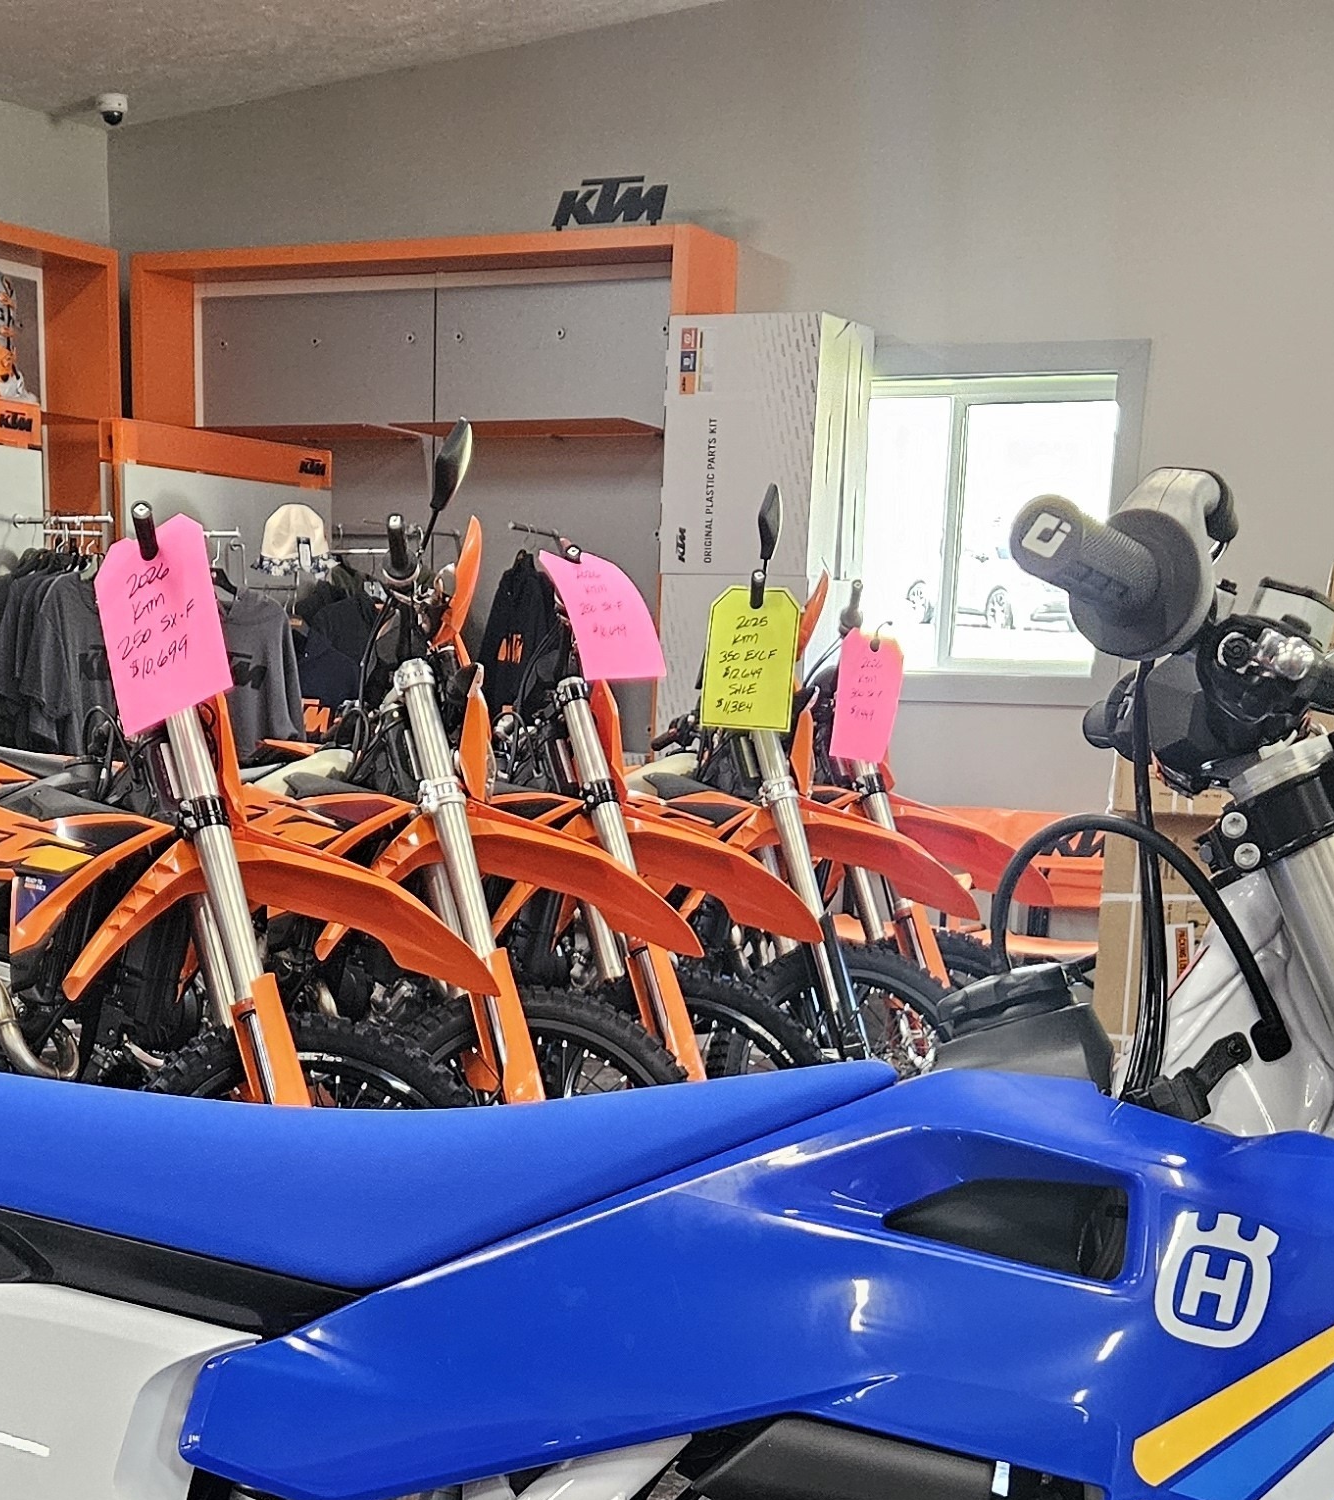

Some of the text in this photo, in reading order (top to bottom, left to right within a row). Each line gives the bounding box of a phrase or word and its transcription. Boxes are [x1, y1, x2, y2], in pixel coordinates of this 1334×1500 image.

[551, 175, 668, 226] KTM
[298, 457, 327, 476] KTM
[704, 418, 718, 564] ORIGINAL PLASTIC PARTS KIT
[677, 527, 687, 563] KTM
[126, 562, 170, 599] 2026
[732, 633, 759, 646] KTM
[736, 615, 768, 630] 2025
[117, 628, 152, 661] 250
[129, 633, 188, 680] $10,699
[718, 650, 741, 664] 350
